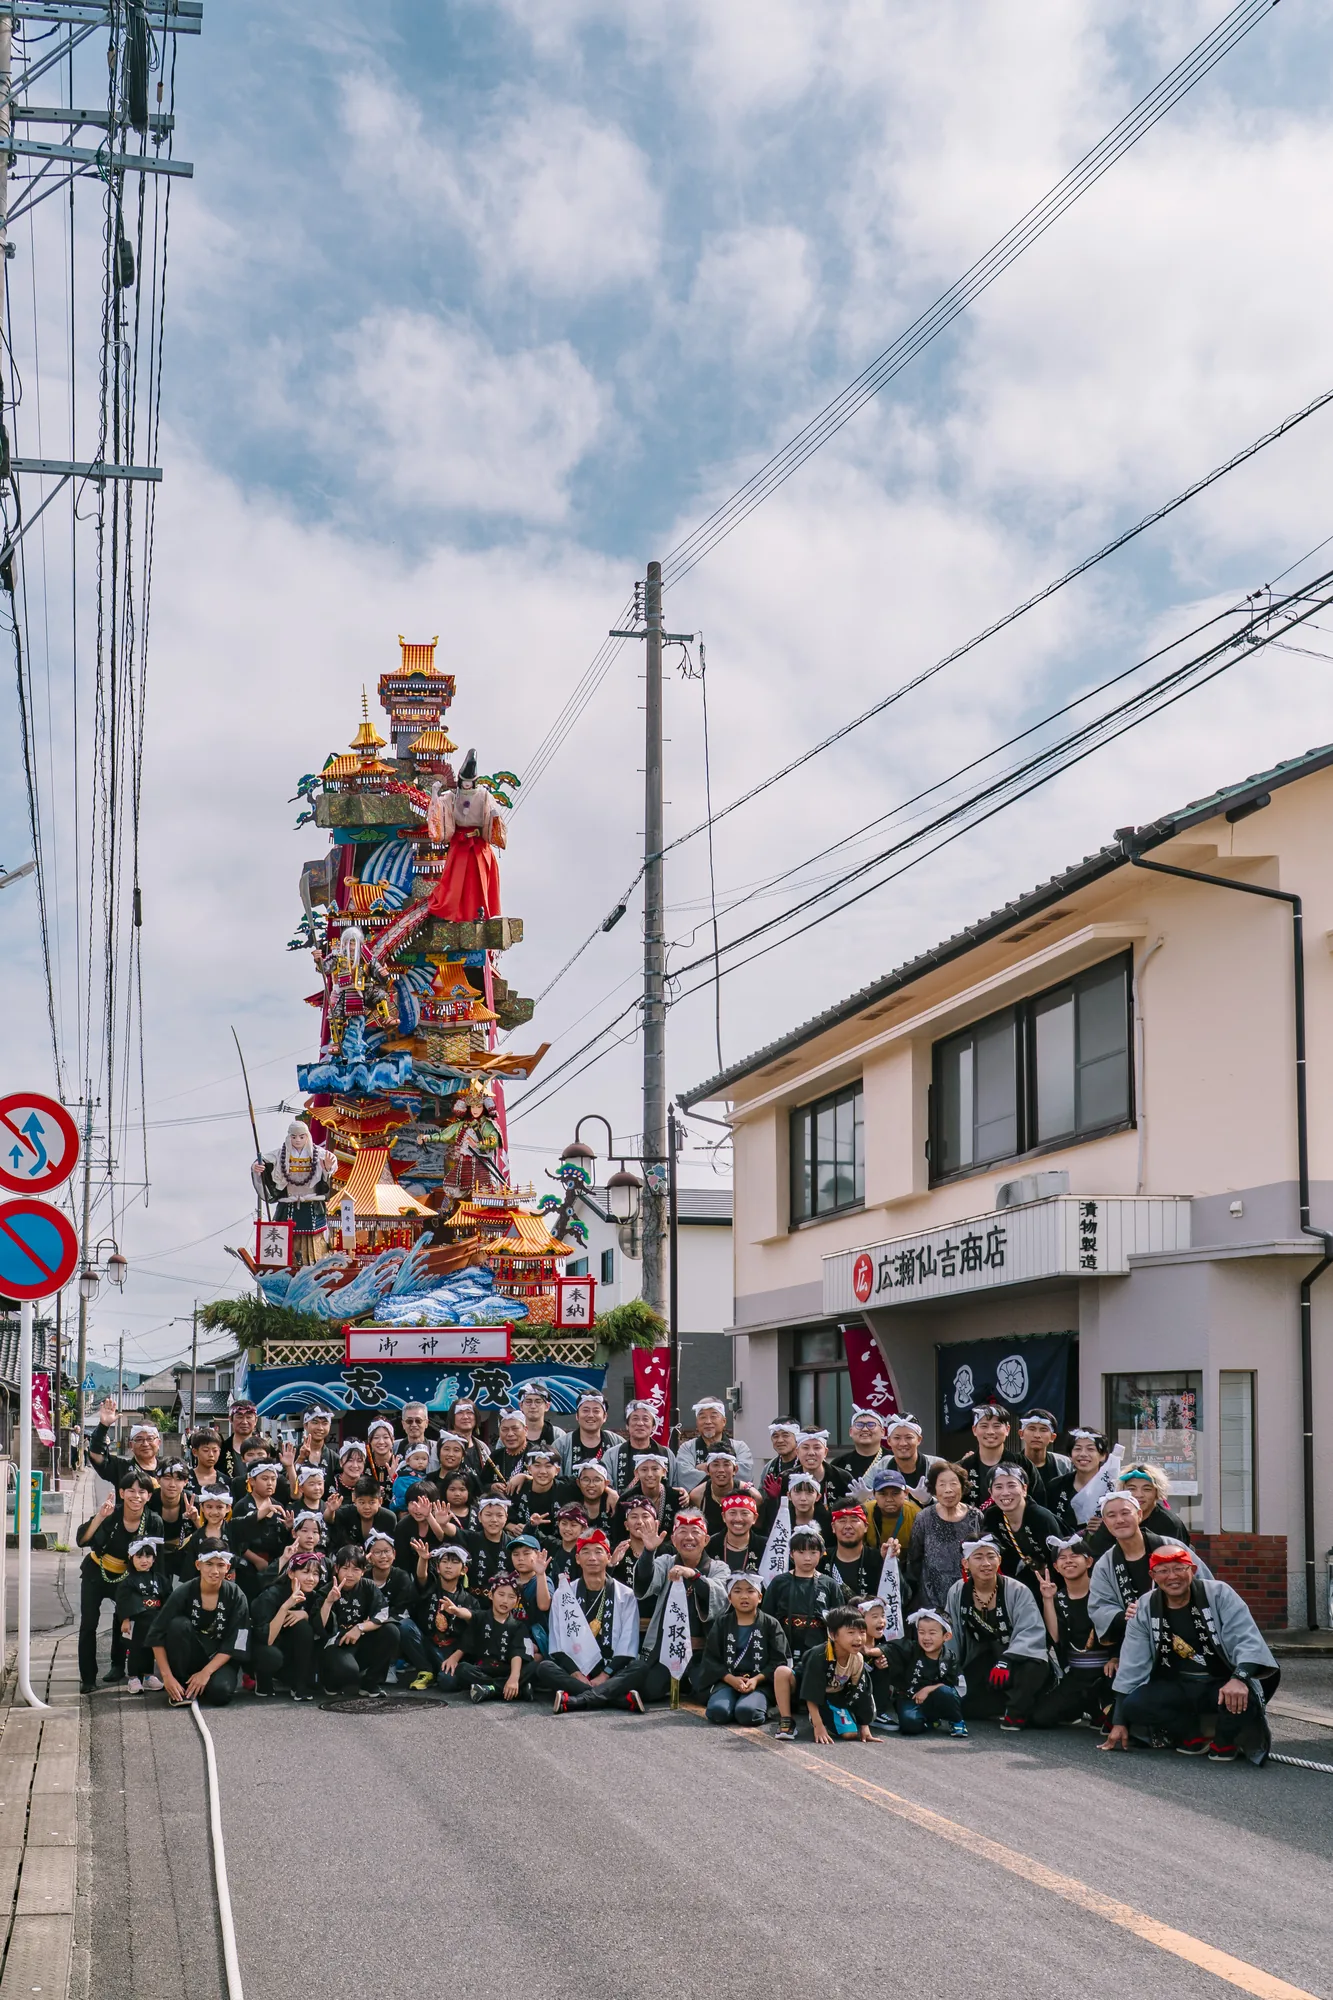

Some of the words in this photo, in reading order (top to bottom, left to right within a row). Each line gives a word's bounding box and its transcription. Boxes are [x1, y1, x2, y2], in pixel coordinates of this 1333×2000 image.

[264, 1227, 284, 1259] 奉納
[1080, 1202, 1099, 1270] 漬物製造
[856, 1260, 868, 1293] 広
[875, 1225, 1007, 1294] 広瀬仙吉商店
[565, 1287, 586, 1318] 奉納
[379, 1336, 481, 1357] 御神燈
[341, 1366, 514, 1408] 志茂
[561, 1592, 581, 1638] 総取締
